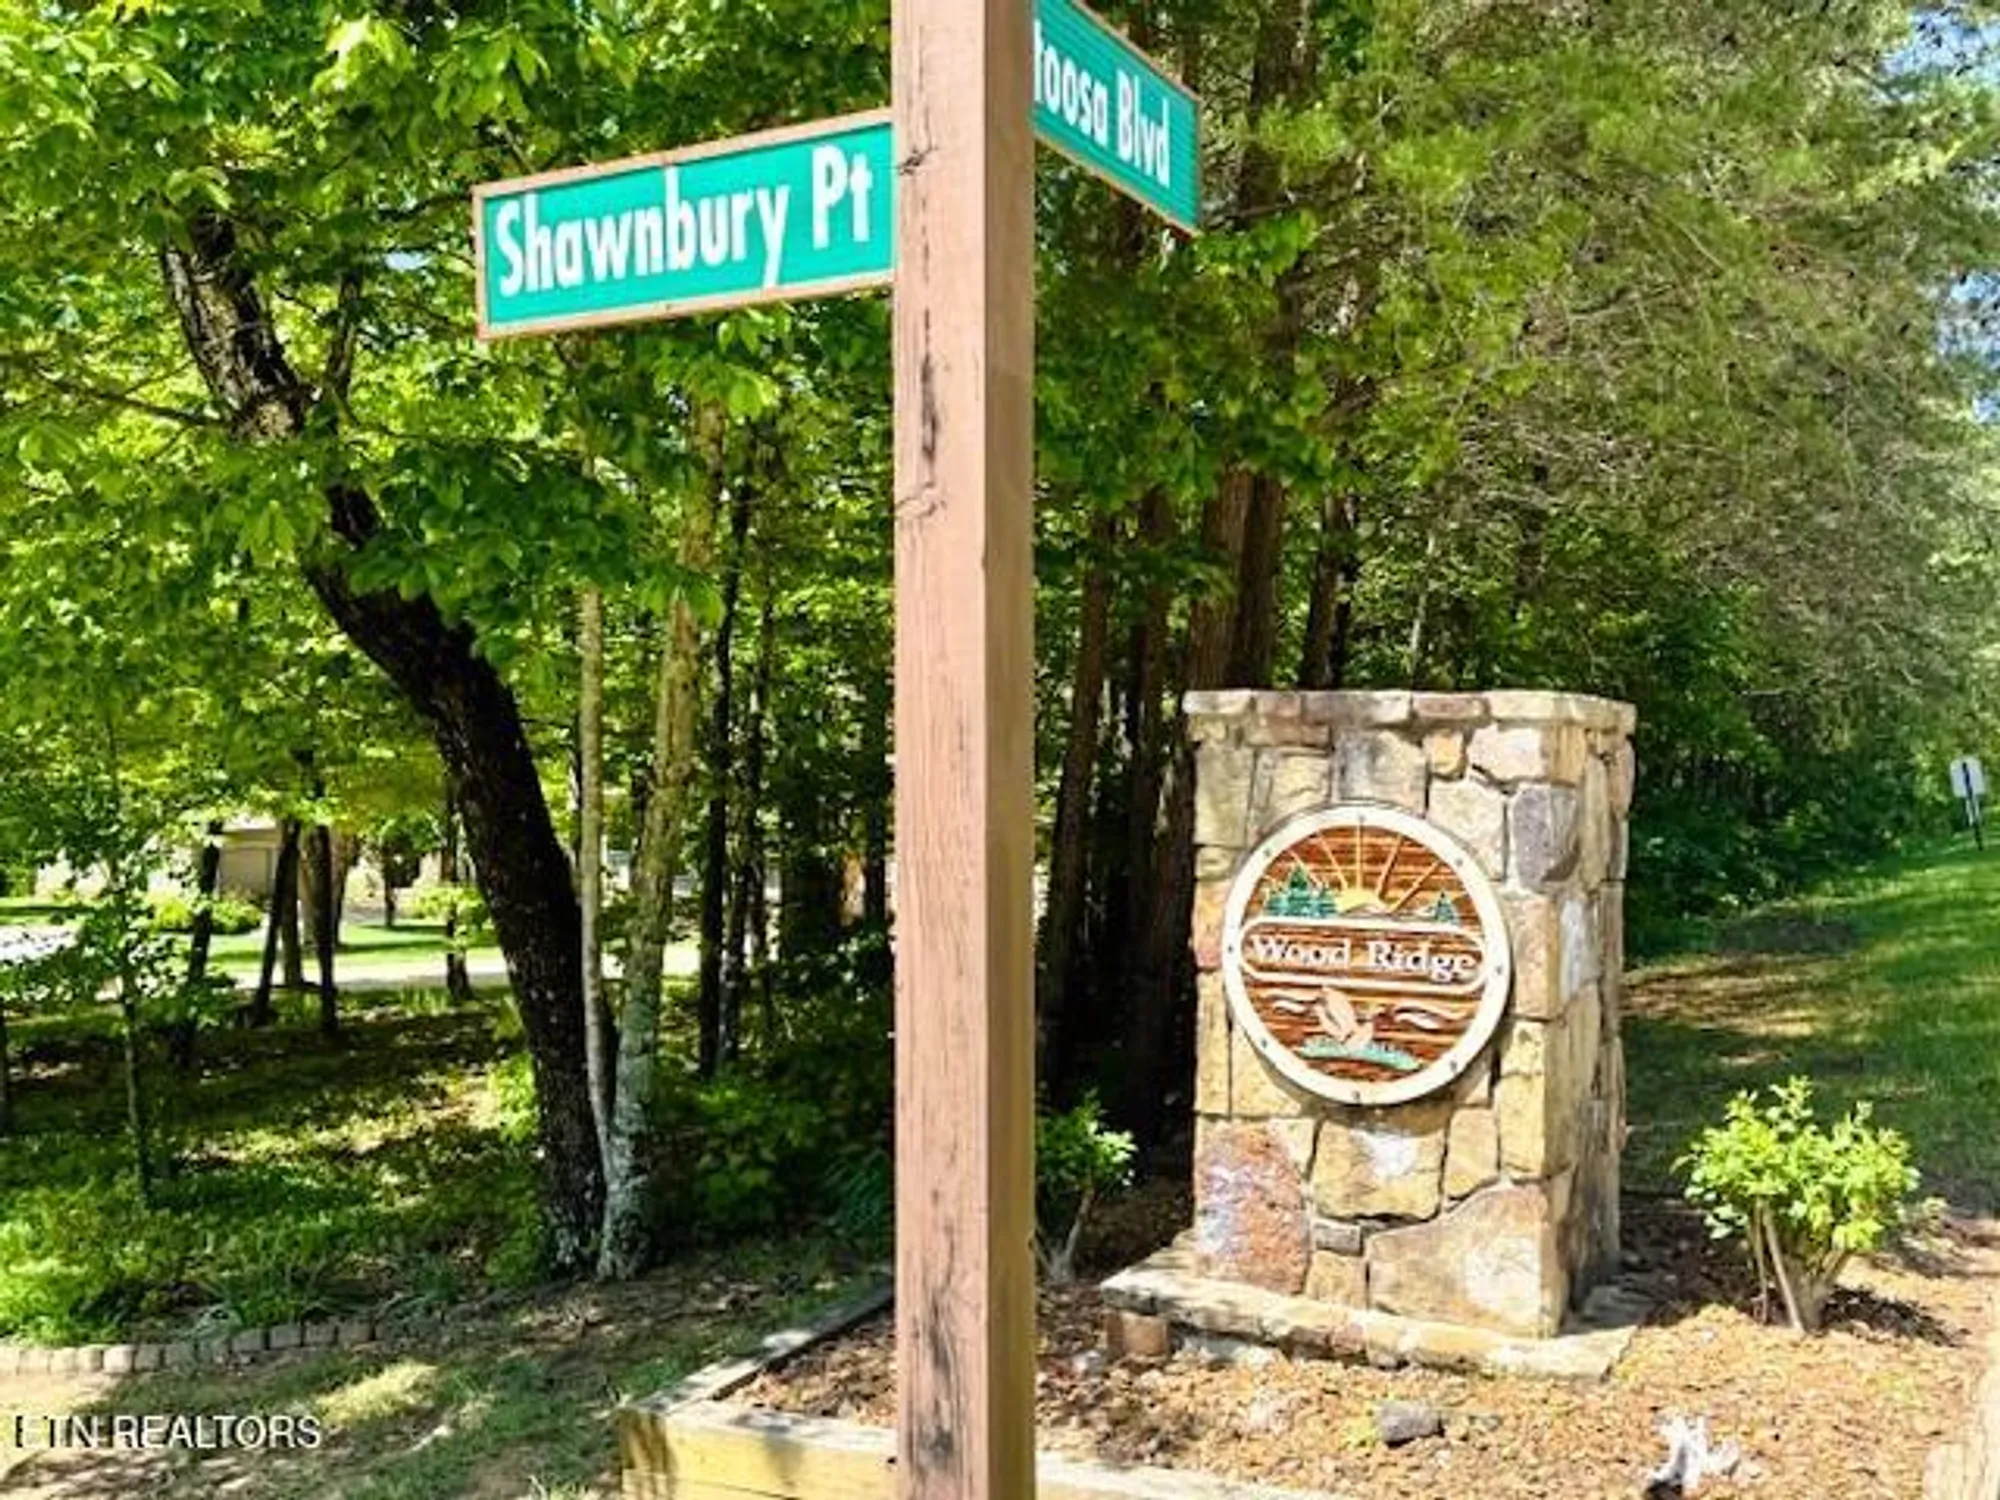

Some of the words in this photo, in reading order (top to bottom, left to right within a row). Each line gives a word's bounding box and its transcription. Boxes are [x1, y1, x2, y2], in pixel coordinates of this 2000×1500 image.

[1117, 69, 1171, 189] Blvd
[496, 165, 789, 298] Shawnbury
[811, 143, 872, 250] Pt
[1252, 934, 1351, 968] Wood
[1365, 938, 1477, 984] Ridge
